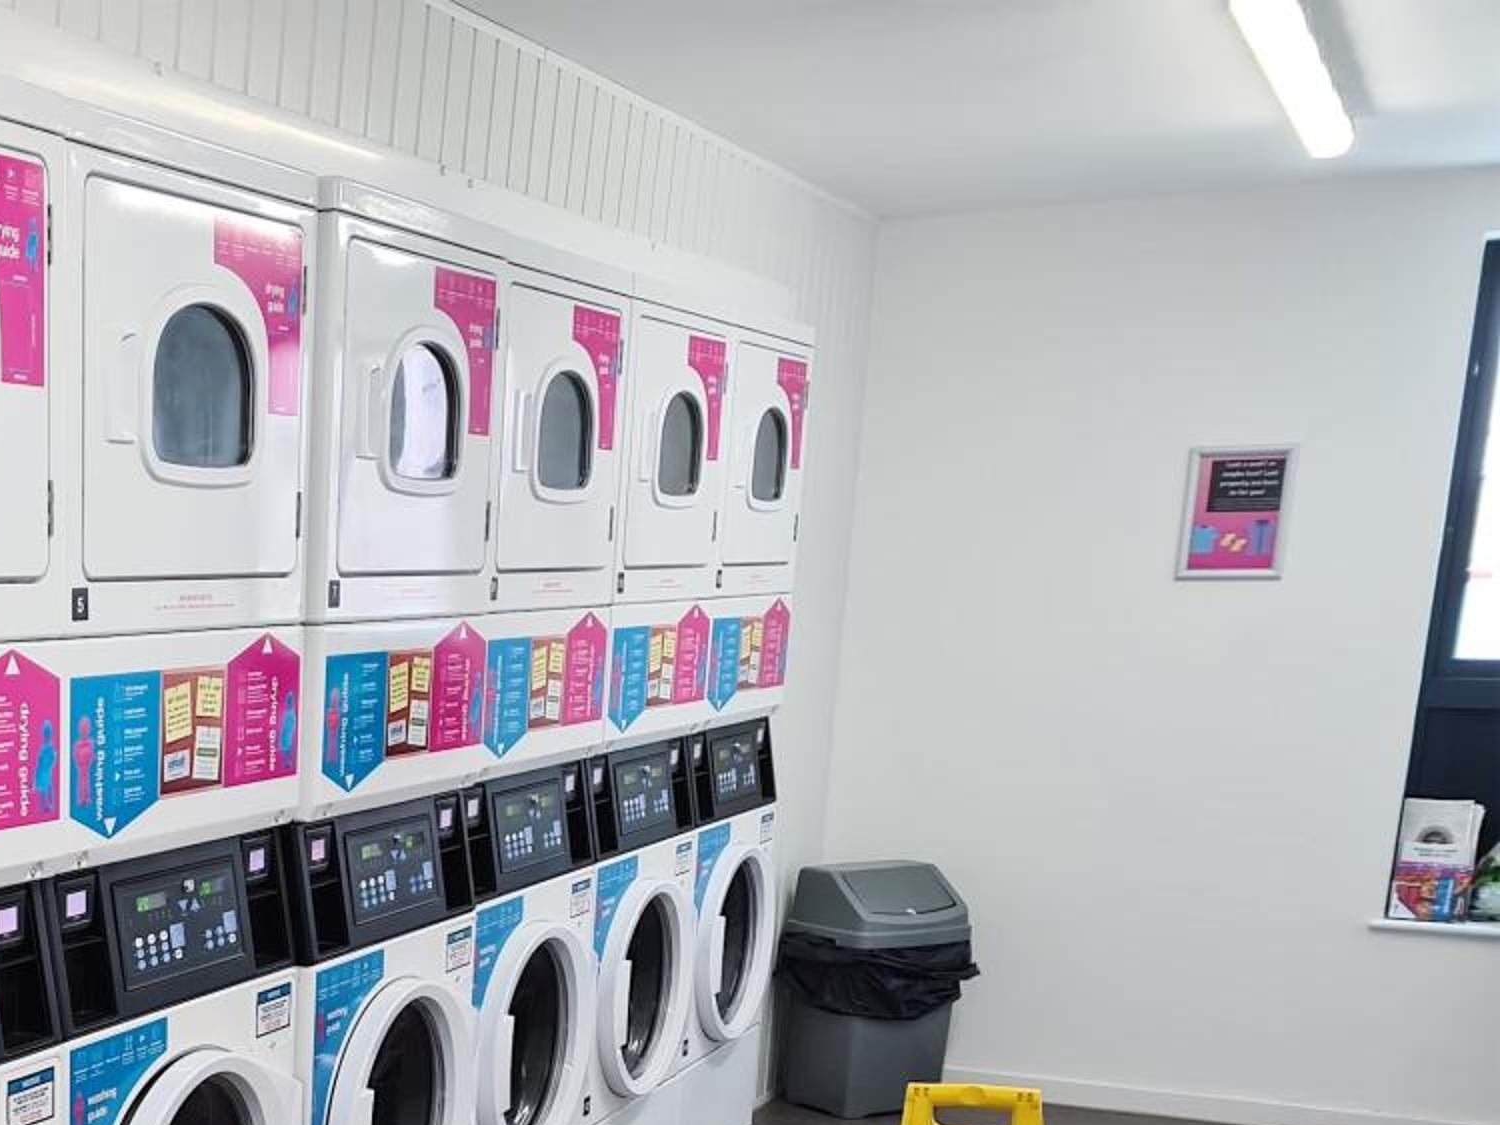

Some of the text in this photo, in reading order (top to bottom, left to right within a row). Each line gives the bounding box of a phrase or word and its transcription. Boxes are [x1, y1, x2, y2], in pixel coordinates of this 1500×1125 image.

[77, 597, 85, 613] 5
[18, 703, 31, 817] drying guide
